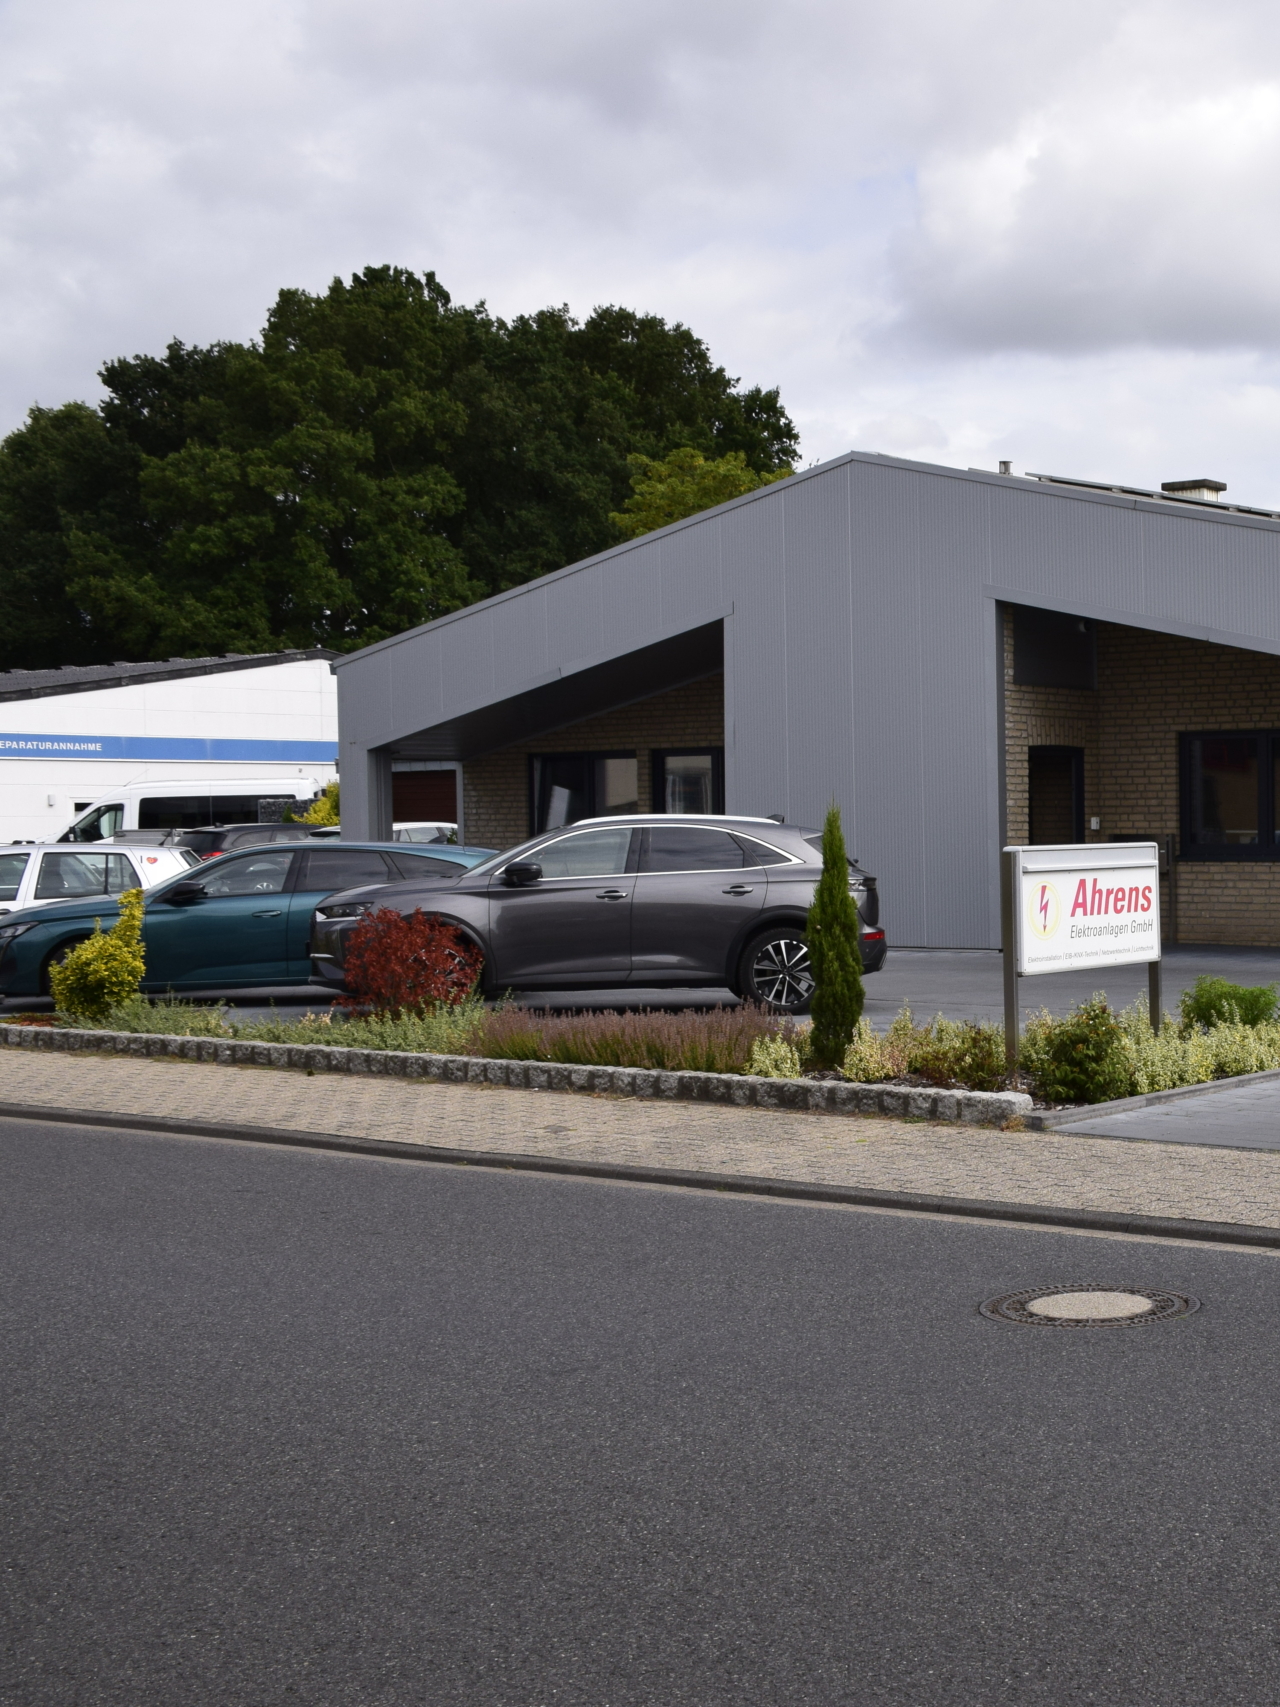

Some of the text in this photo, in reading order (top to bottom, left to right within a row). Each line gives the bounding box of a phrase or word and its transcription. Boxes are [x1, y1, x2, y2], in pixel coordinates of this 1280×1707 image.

[1070, 877, 1153, 918] Ahrens
[1070, 918, 1154, 939] Elektroanlagen GmbH
[1027, 953, 1063, 963] Elektroinstallation
[1101, 947, 1131, 956] Netzwerktechnik
[1133, 945, 1154, 953] Lichttechnik
